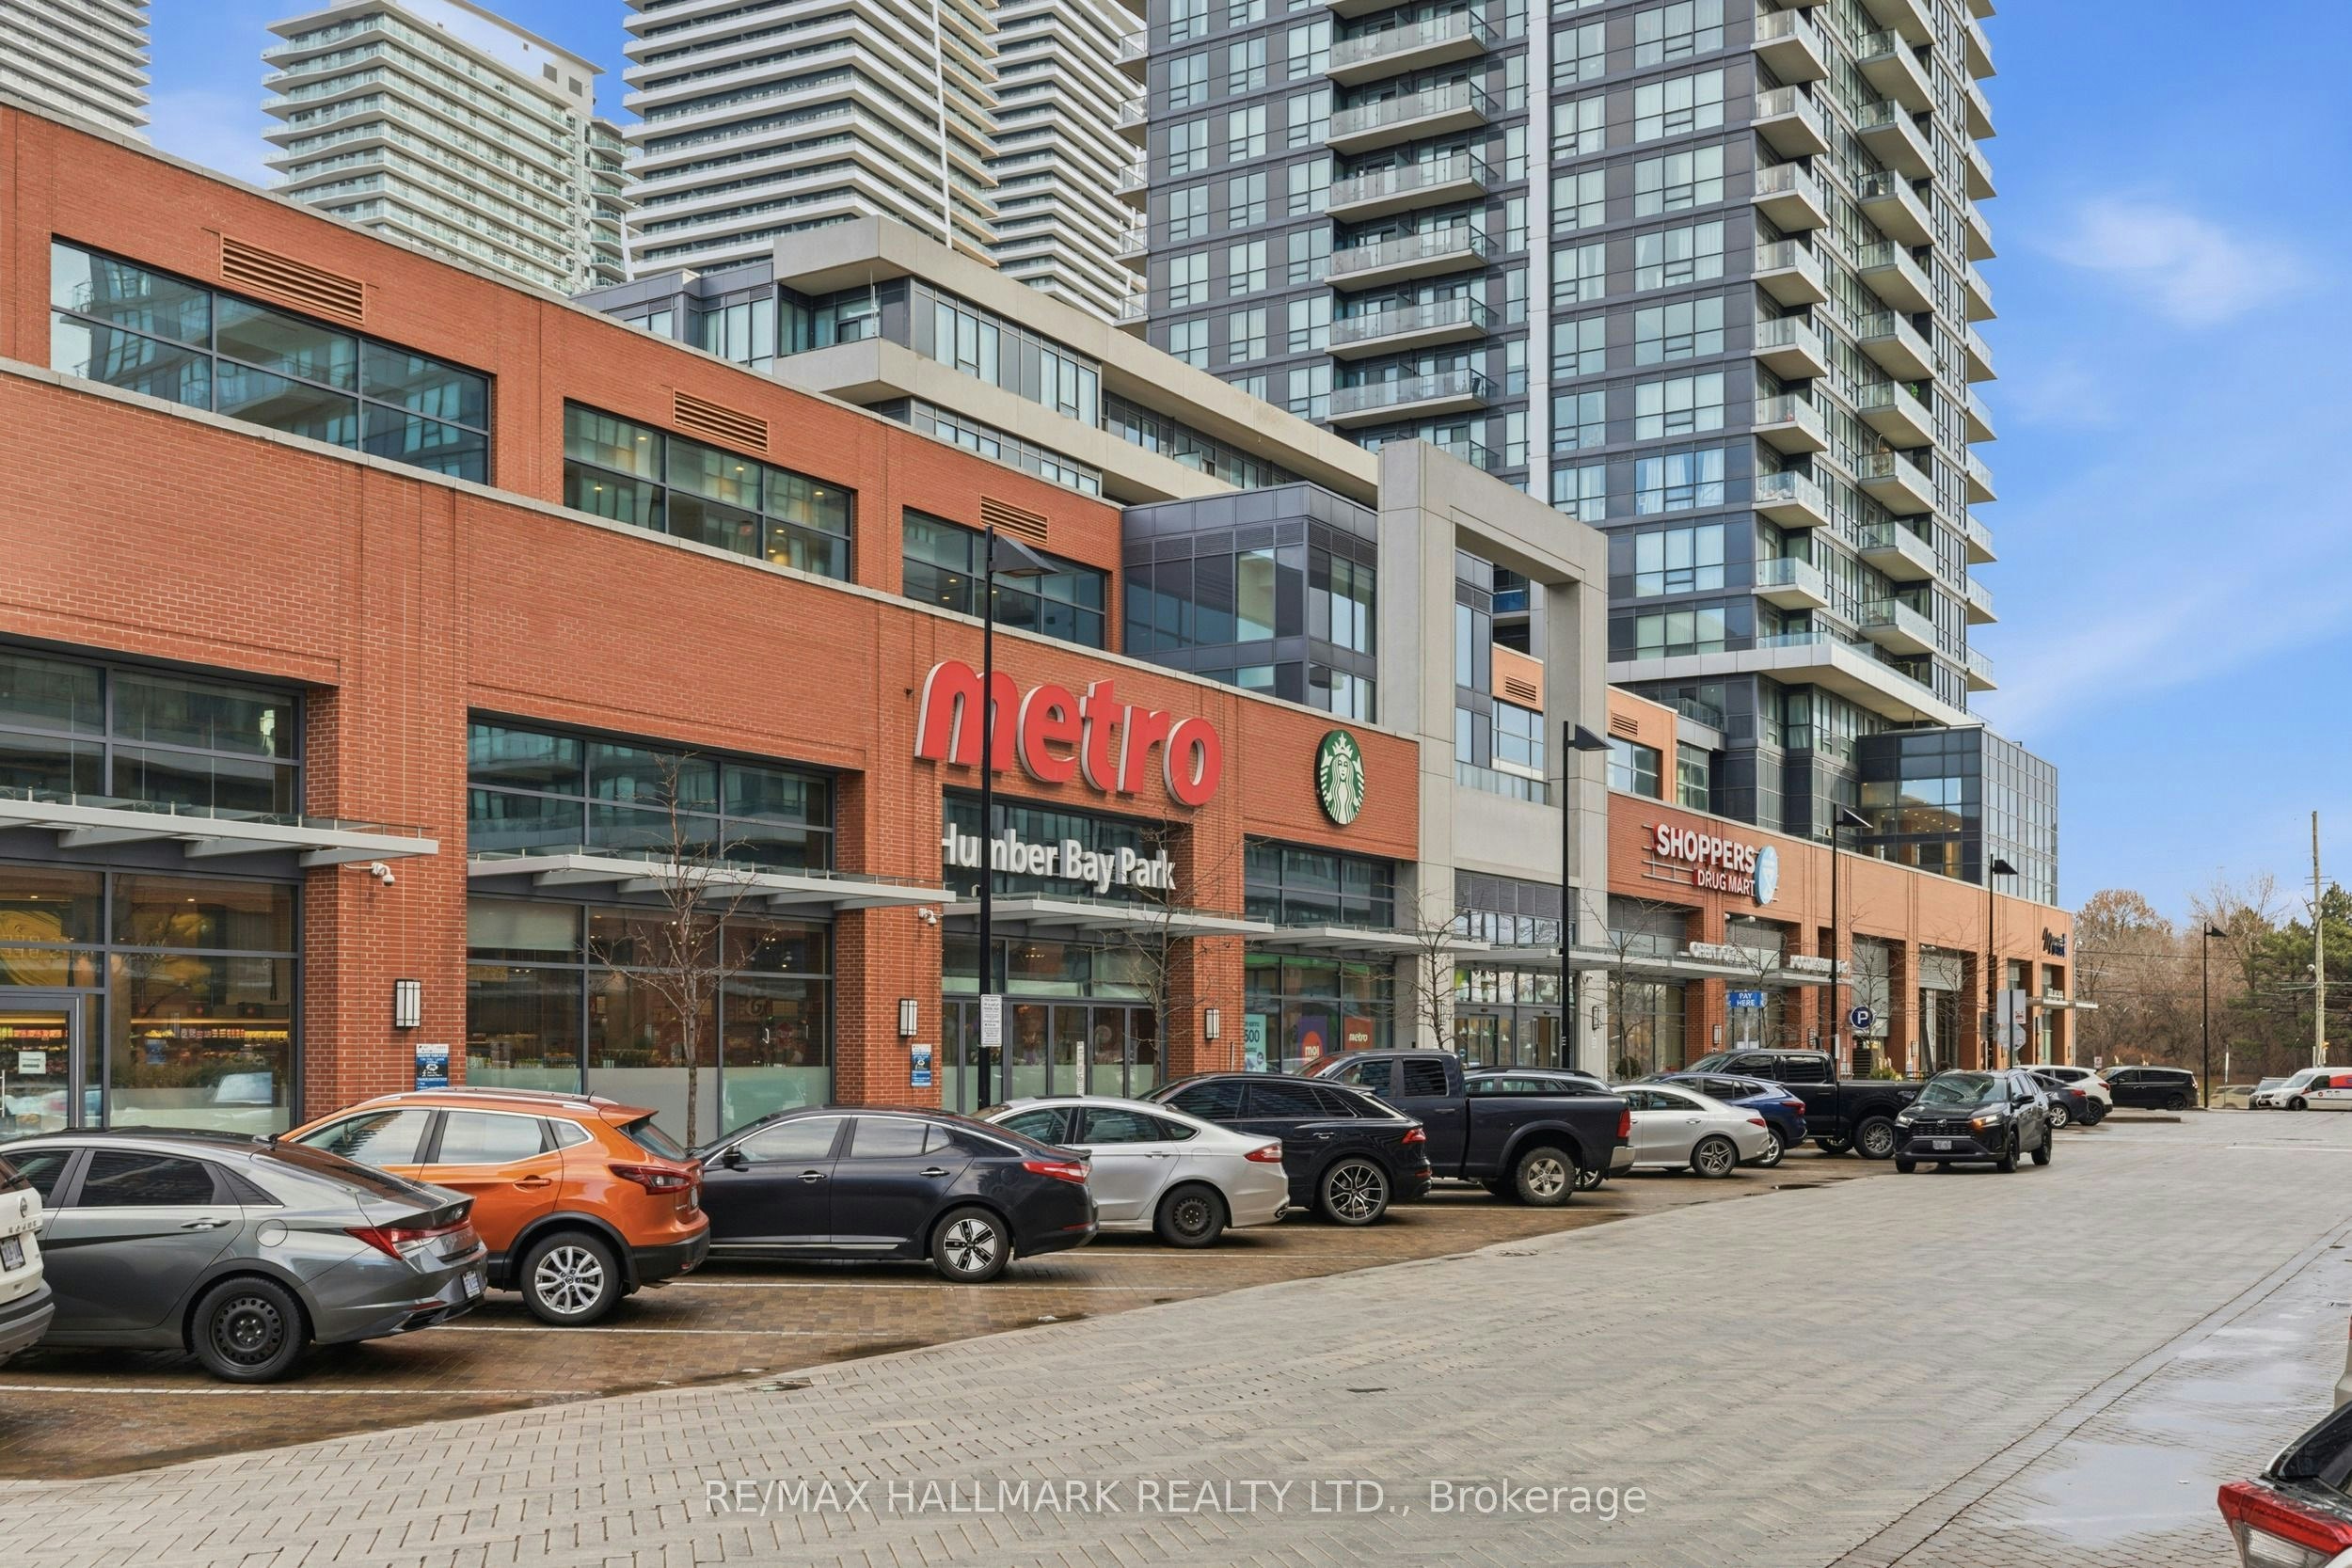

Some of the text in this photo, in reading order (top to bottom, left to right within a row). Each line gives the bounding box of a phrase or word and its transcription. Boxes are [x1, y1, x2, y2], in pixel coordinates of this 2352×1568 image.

[914, 660, 1221, 806] metro
[1654, 823, 1756, 874] SHOPPERS
[1059, 838, 1115, 894] Bay
[1115, 847, 1177, 890] Park
[1697, 868, 1756, 897] DRUG MART
[1737, 999, 1756, 1007] HERE
[1857, 1010, 1869, 1025] P
[1348, 1032, 1369, 1042] metro
